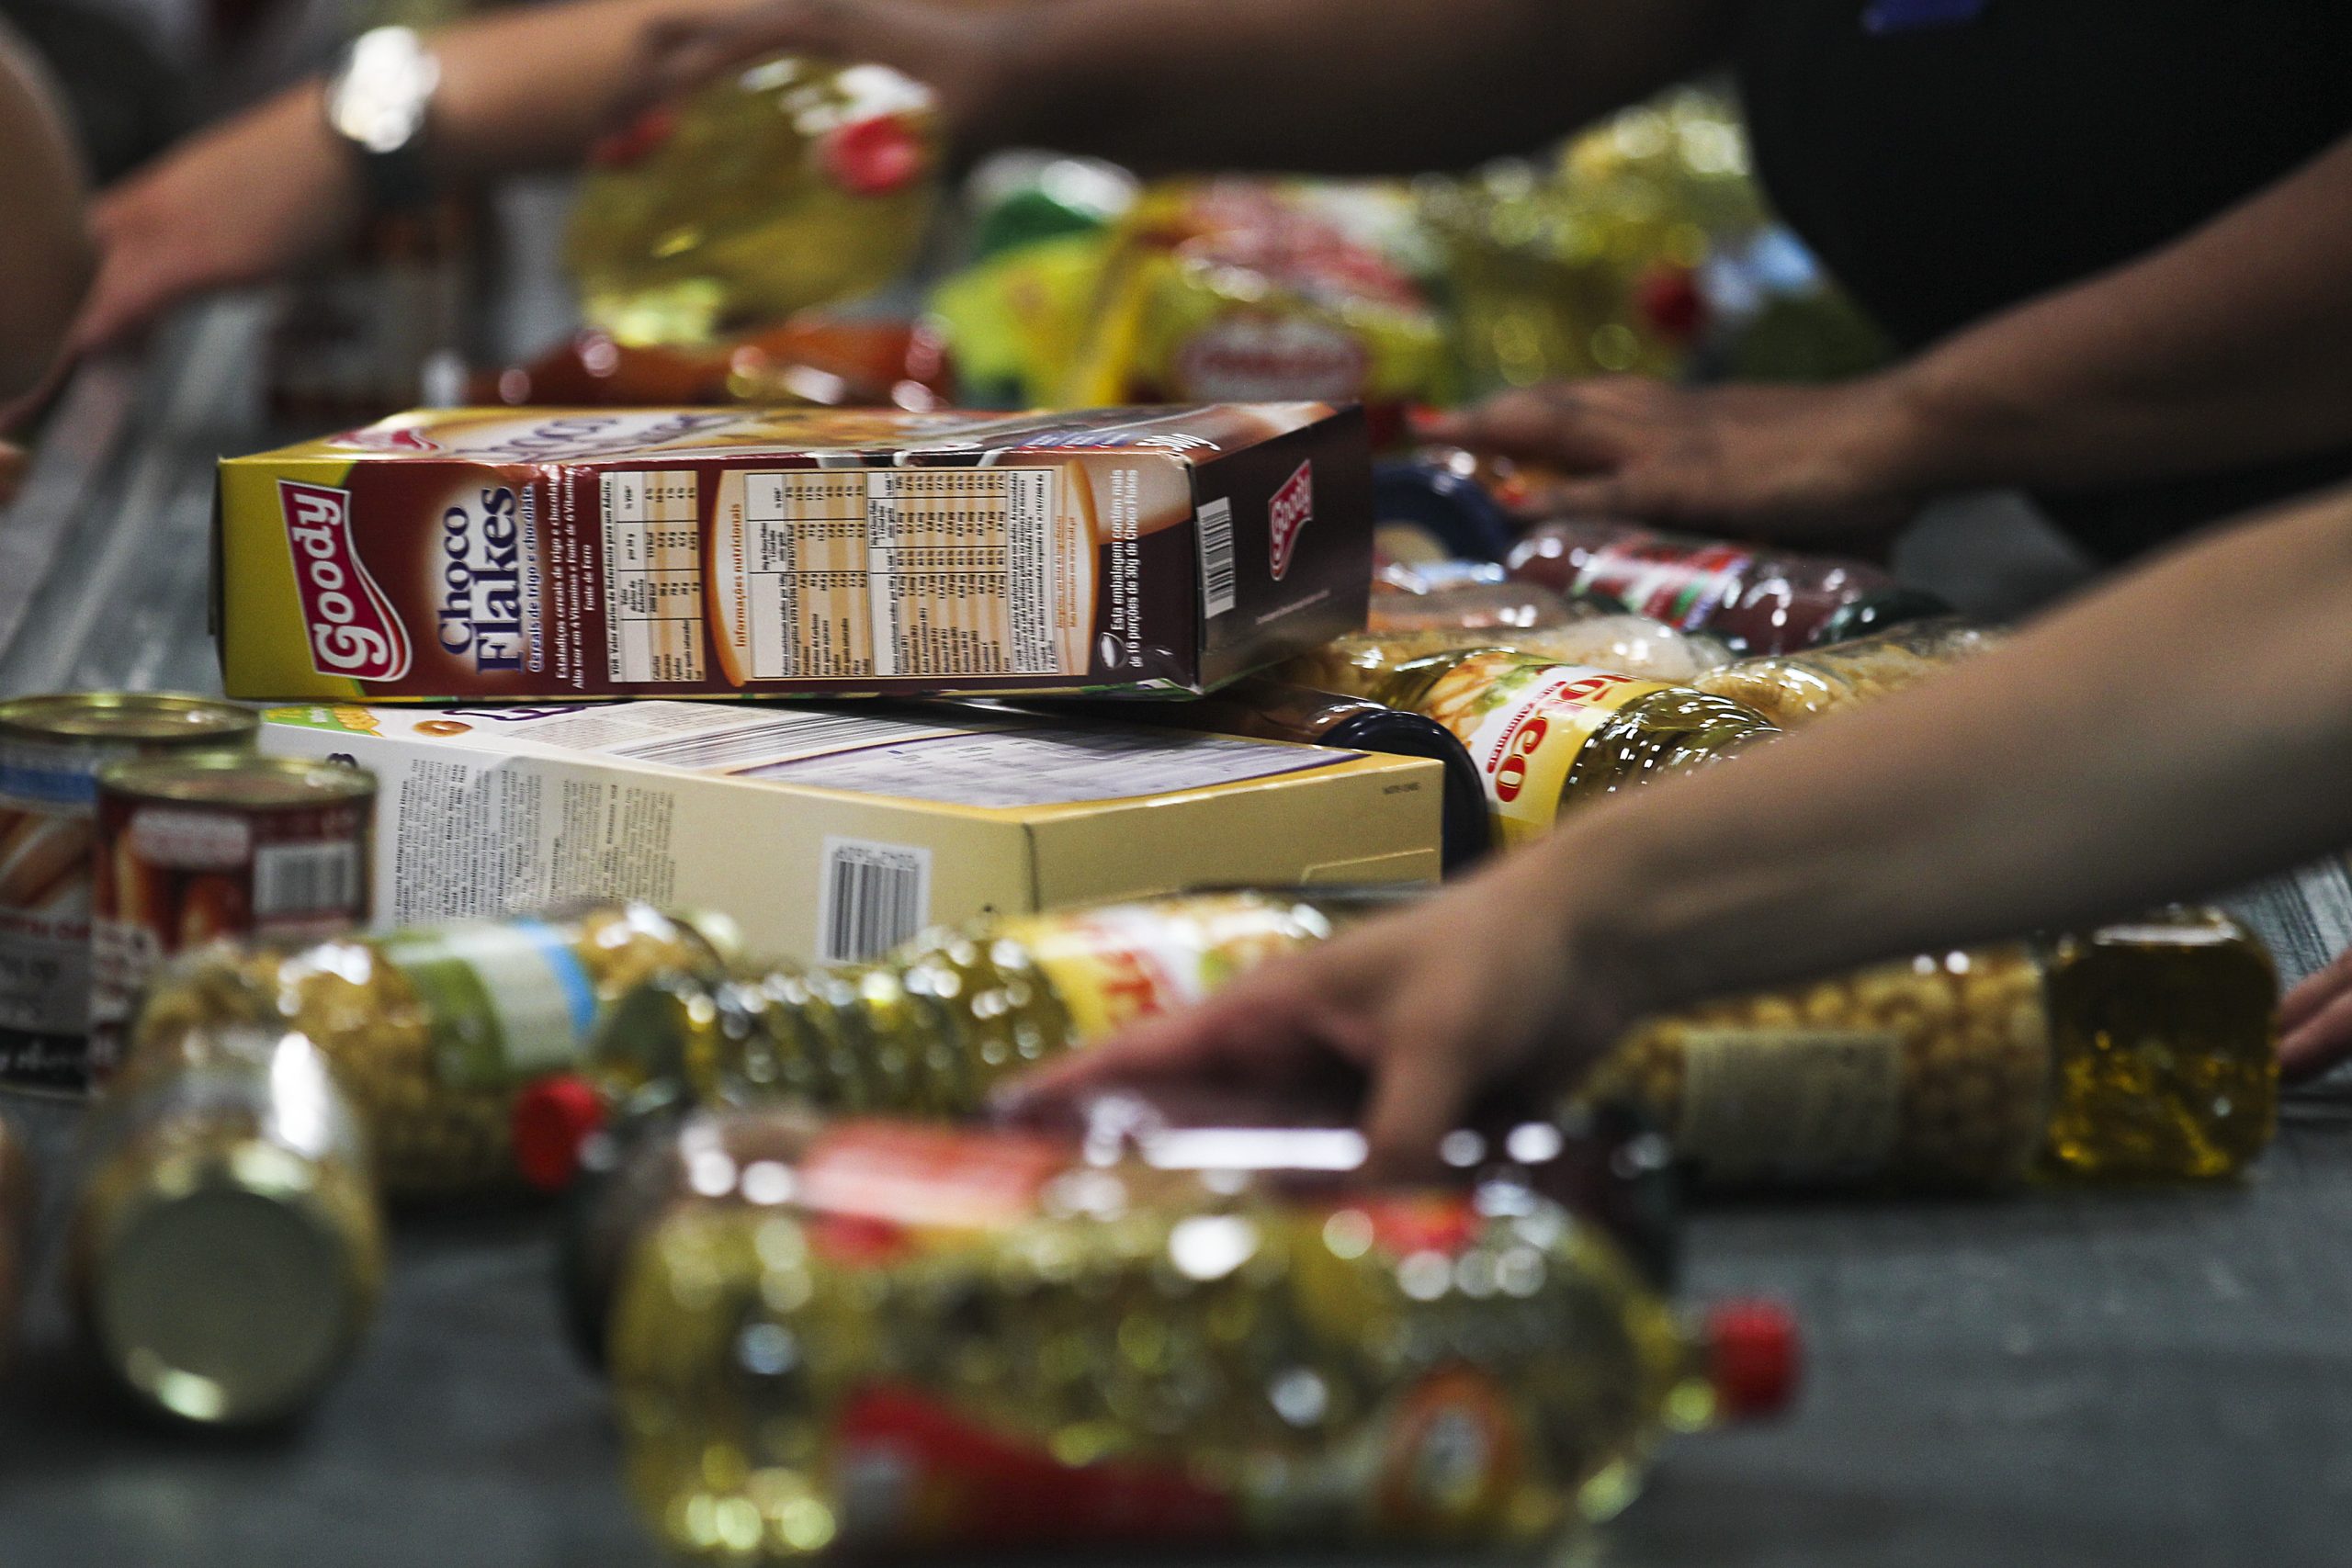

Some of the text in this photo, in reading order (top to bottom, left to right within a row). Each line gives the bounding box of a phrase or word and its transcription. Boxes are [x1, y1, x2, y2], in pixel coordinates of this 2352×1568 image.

[565, 524, 575, 535] de
[550, 538, 563, 563] trigo
[566, 538, 578, 563] Fonte
[1110, 470, 1125, 630] Esta embalagem contém mais
[1125, 470, 1143, 667] de 16 porções de 30g de Choco Flakes
[292, 493, 388, 669] Goody
[437, 507, 472, 655] Choco
[469, 487, 524, 673] Flakes
[525, 566, 540, 598] trigo
[551, 566, 562, 578] de
[582, 545, 595, 611] Fonte de Ferro
[729, 503, 748, 647] Informações nutricionais
[526, 603, 538, 618] de
[569, 574, 580, 619] Vitaminas
[556, 621, 569, 679] Estaladiços
[572, 631, 582, 645] em
[572, 648, 582, 667] teor
[573, 669, 584, 689] Alto
